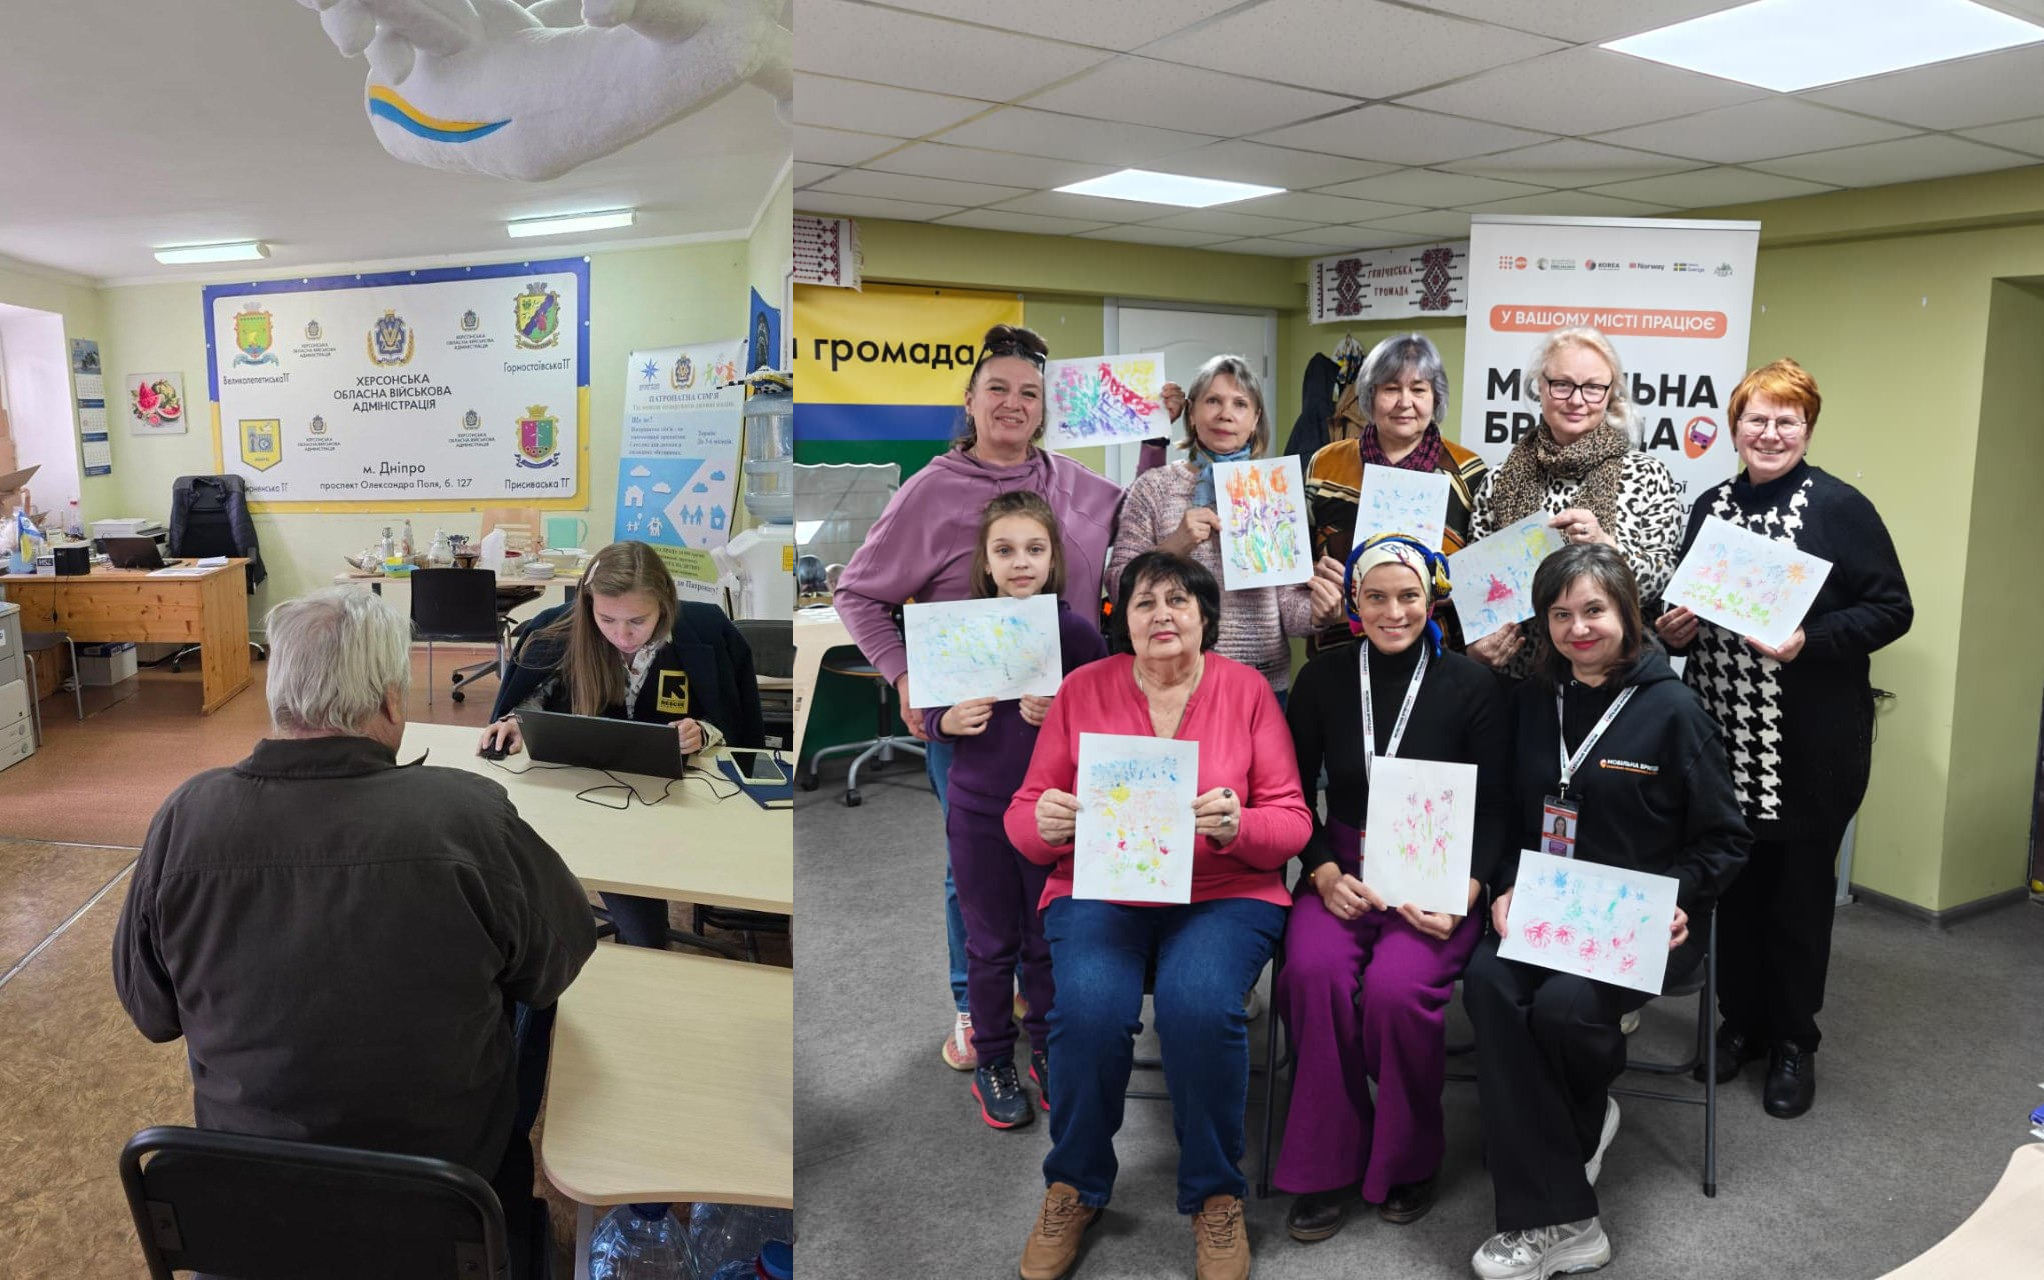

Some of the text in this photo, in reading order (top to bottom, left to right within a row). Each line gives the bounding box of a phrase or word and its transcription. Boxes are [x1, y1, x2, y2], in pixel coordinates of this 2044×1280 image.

[1637, 262, 1665, 271] Norway
[1374, 286, 1409, 297] ГРОМАДА
[1501, 311, 1717, 332] У ВАШОМУ МІСТІ ПРАЦЮЄ
[814, 339, 975, 371] громада
[356, 374, 430, 386] ХЕРСОНСЬКА
[333, 386, 452, 400] ОБЛАСНА ВІЙСЬКОВА
[1487, 368, 1718, 408] МЬНА
[352, 399, 436, 413] АДМІНІСТРАЦІЯ
[363, 461, 426, 476] м. Дніпро
[320, 478, 473, 491] проспект Олександра Поля, б. 127
[504, 480, 559, 491] Присиваська
